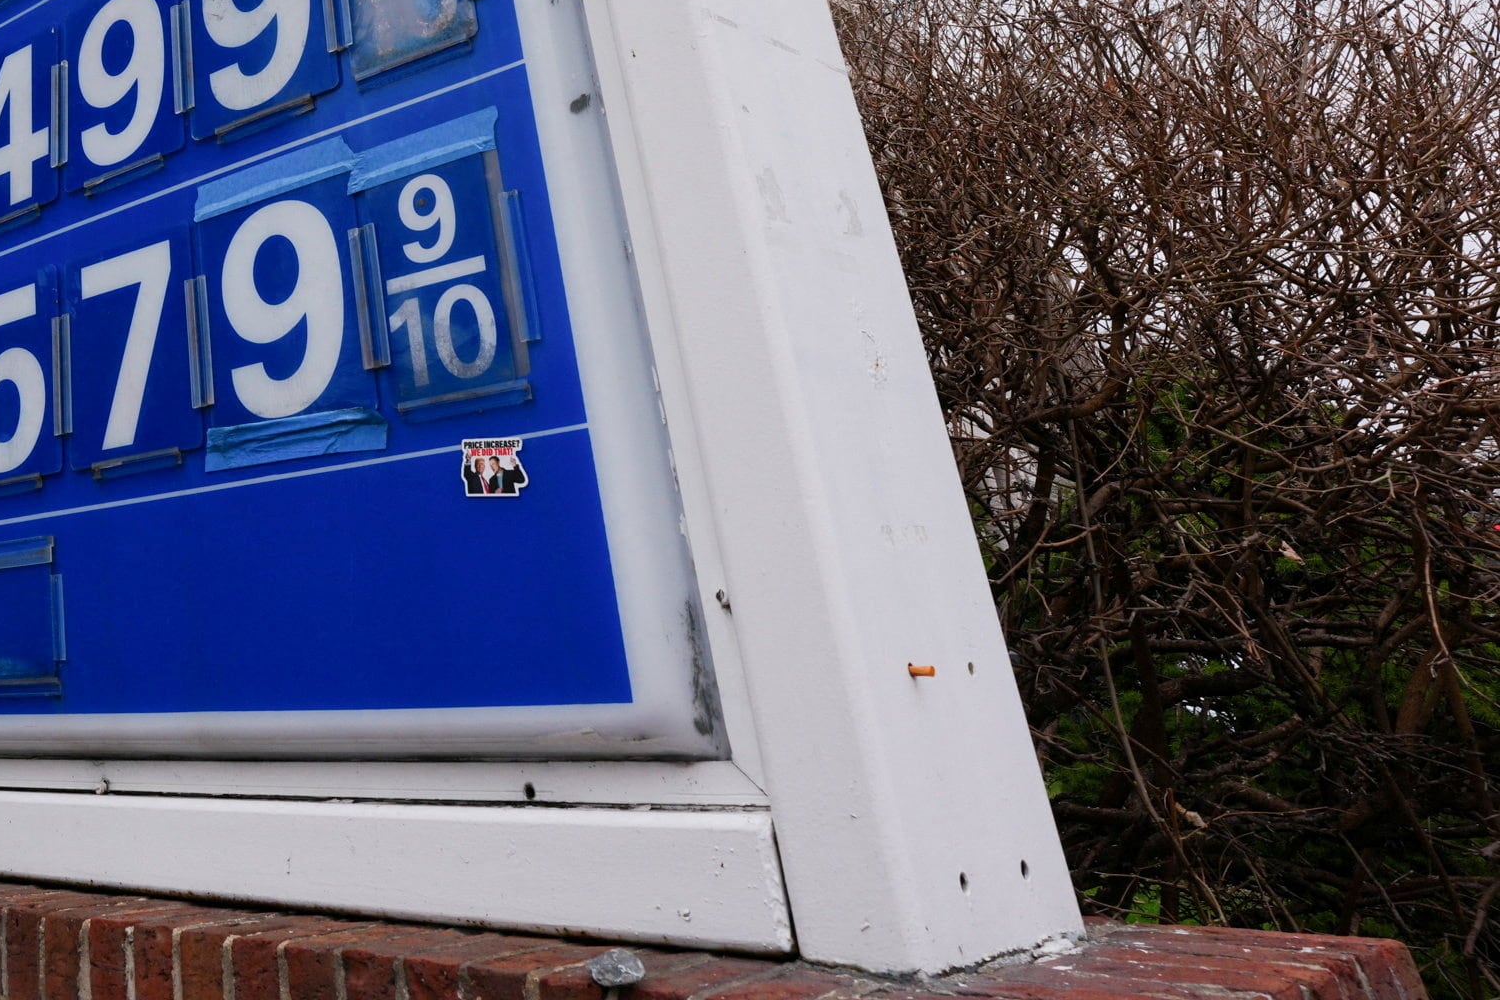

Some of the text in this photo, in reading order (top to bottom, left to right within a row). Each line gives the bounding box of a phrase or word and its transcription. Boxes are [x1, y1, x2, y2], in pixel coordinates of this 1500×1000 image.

[398, 173, 456, 264] 9
[388, 283, 498, 388] 10
[463, 441, 483, 449] PRICE
[482, 448, 494, 456] DID
